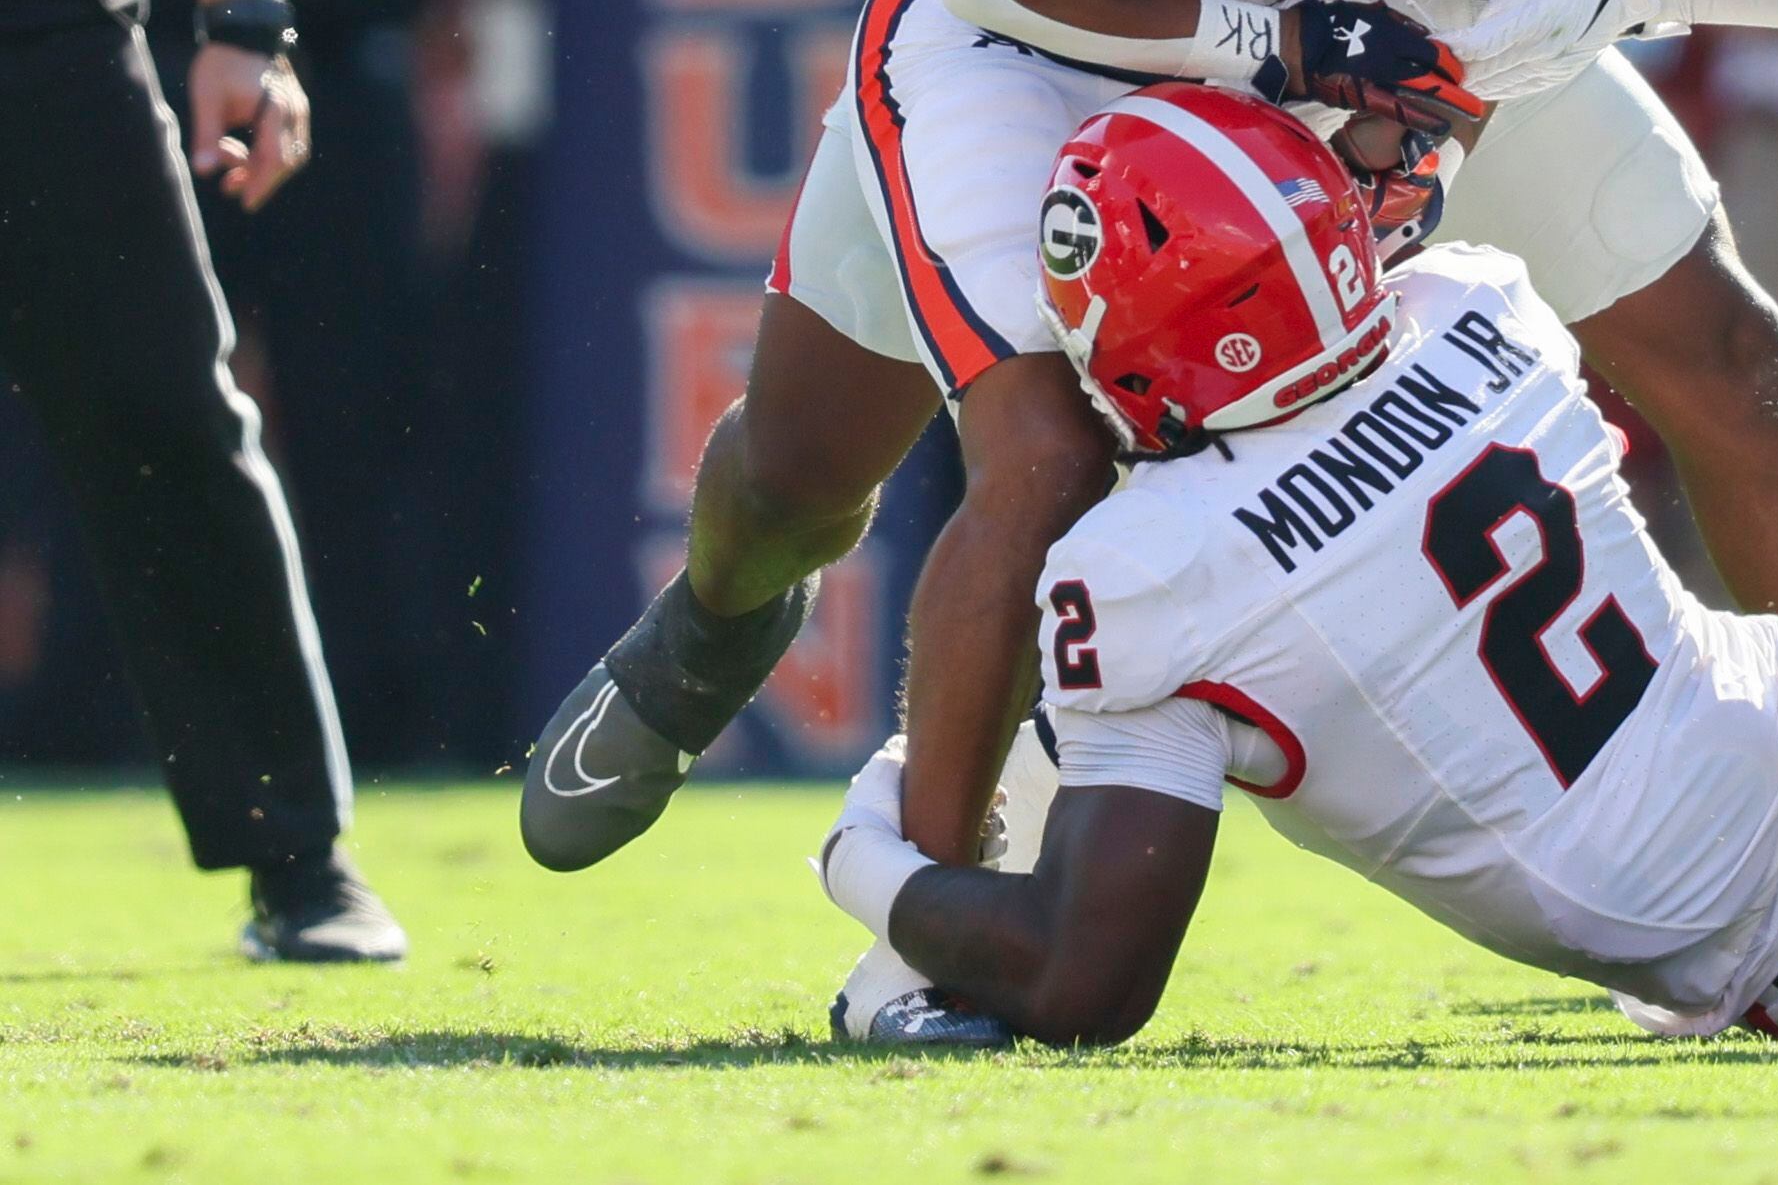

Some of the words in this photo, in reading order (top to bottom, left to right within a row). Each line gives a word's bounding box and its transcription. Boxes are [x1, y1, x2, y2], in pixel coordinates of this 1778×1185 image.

[1328, 243, 1367, 313] 2
[1218, 337, 1259, 370] SEC
[1232, 363, 1482, 574] MONDON
[1049, 579, 1102, 691] 2
[1421, 441, 1659, 790] 2
